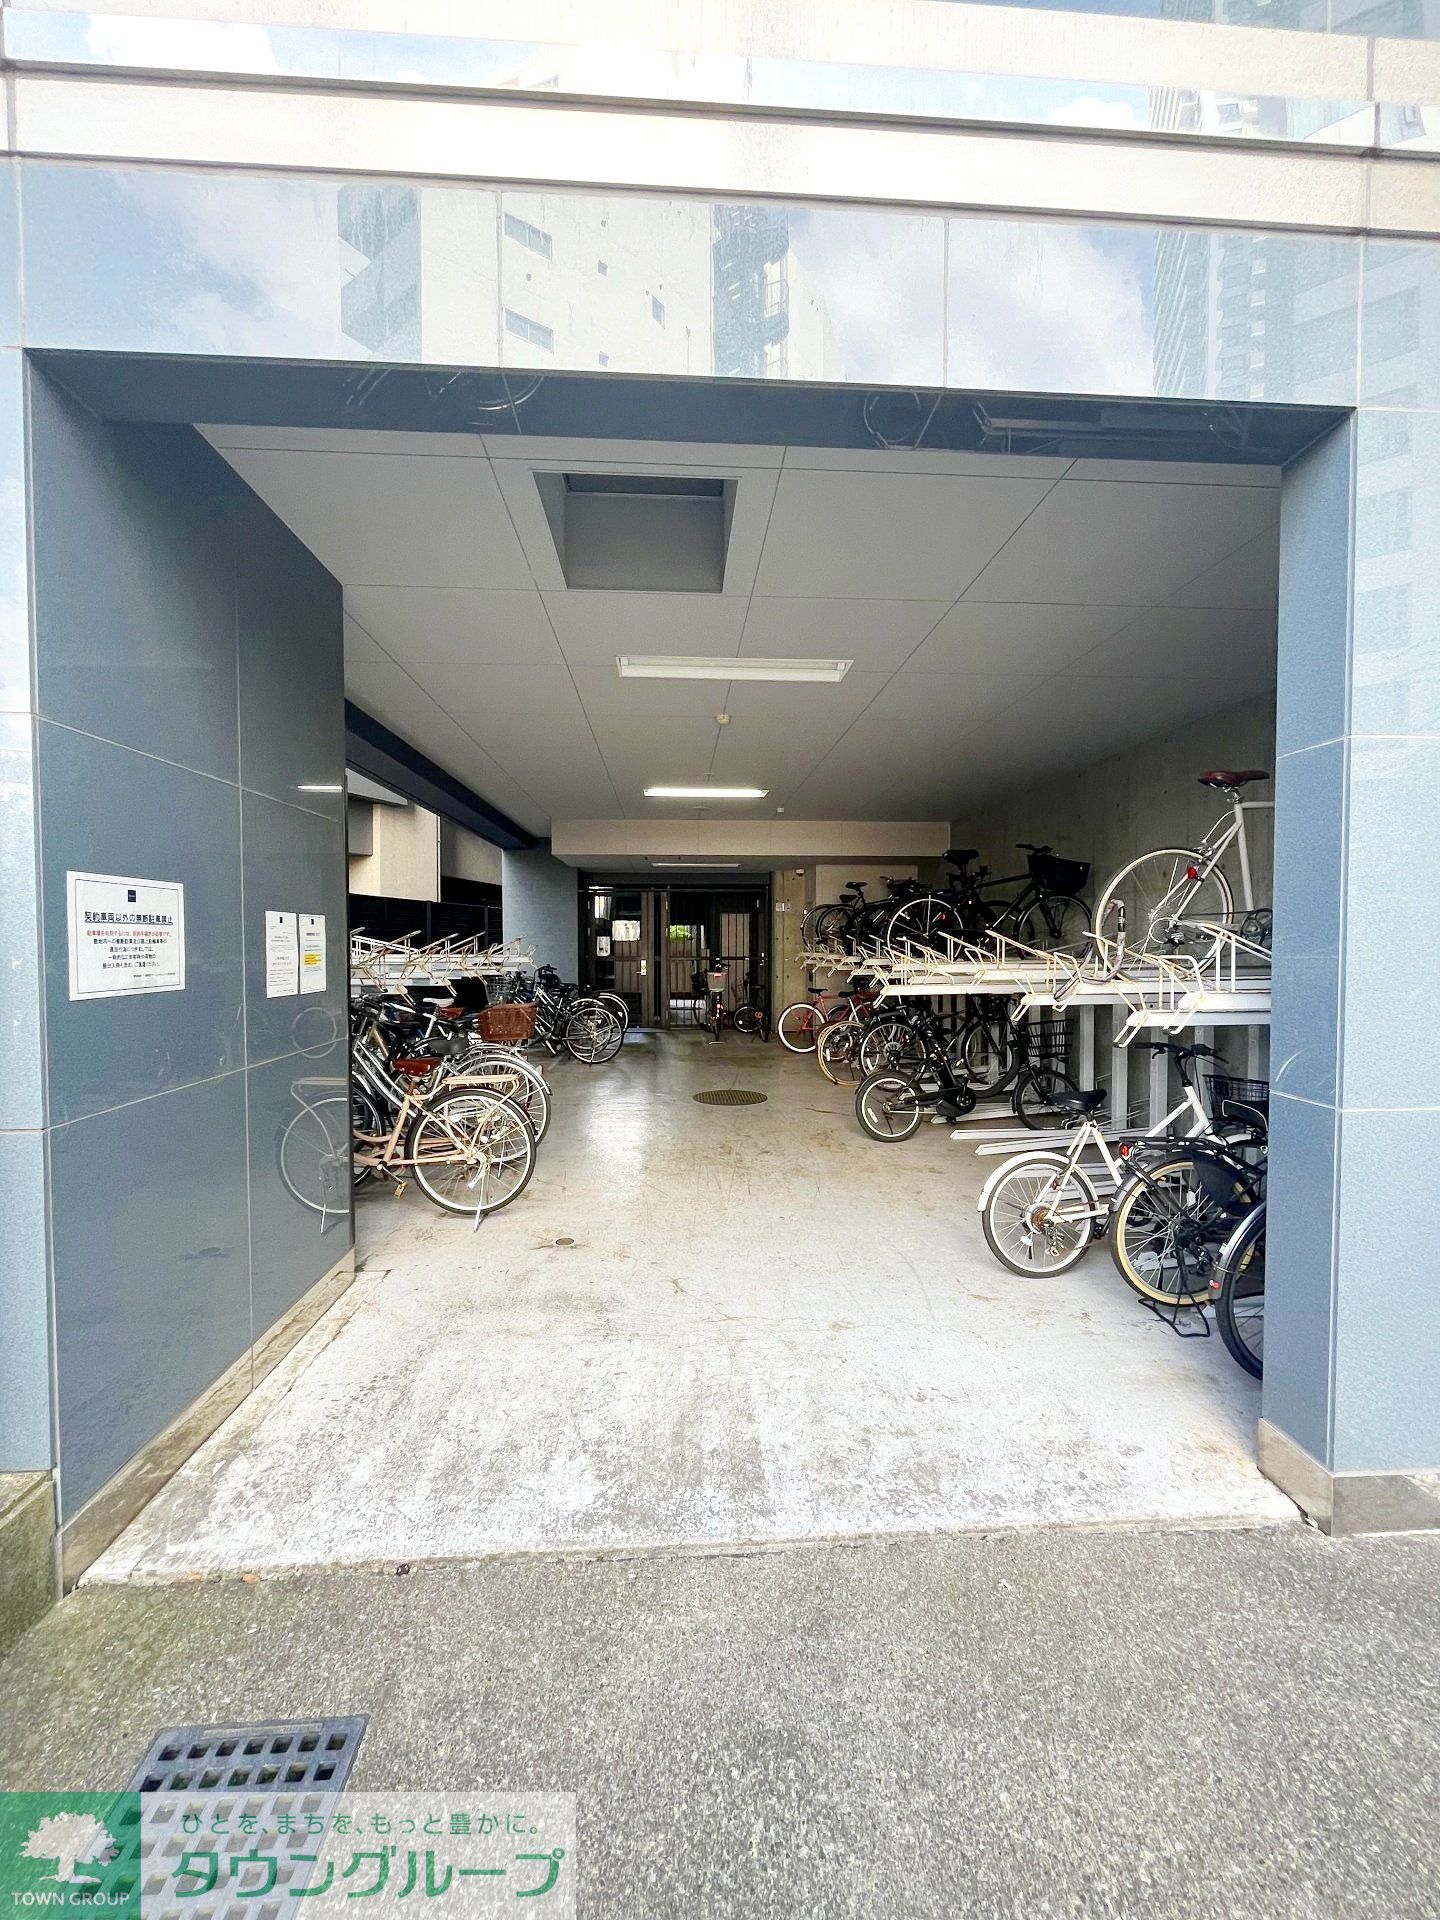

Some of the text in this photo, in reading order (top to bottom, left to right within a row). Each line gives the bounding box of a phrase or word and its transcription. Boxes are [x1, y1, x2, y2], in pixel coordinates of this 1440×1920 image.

[84, 911, 173, 924] 契約車両以外の無断駐車禁止
